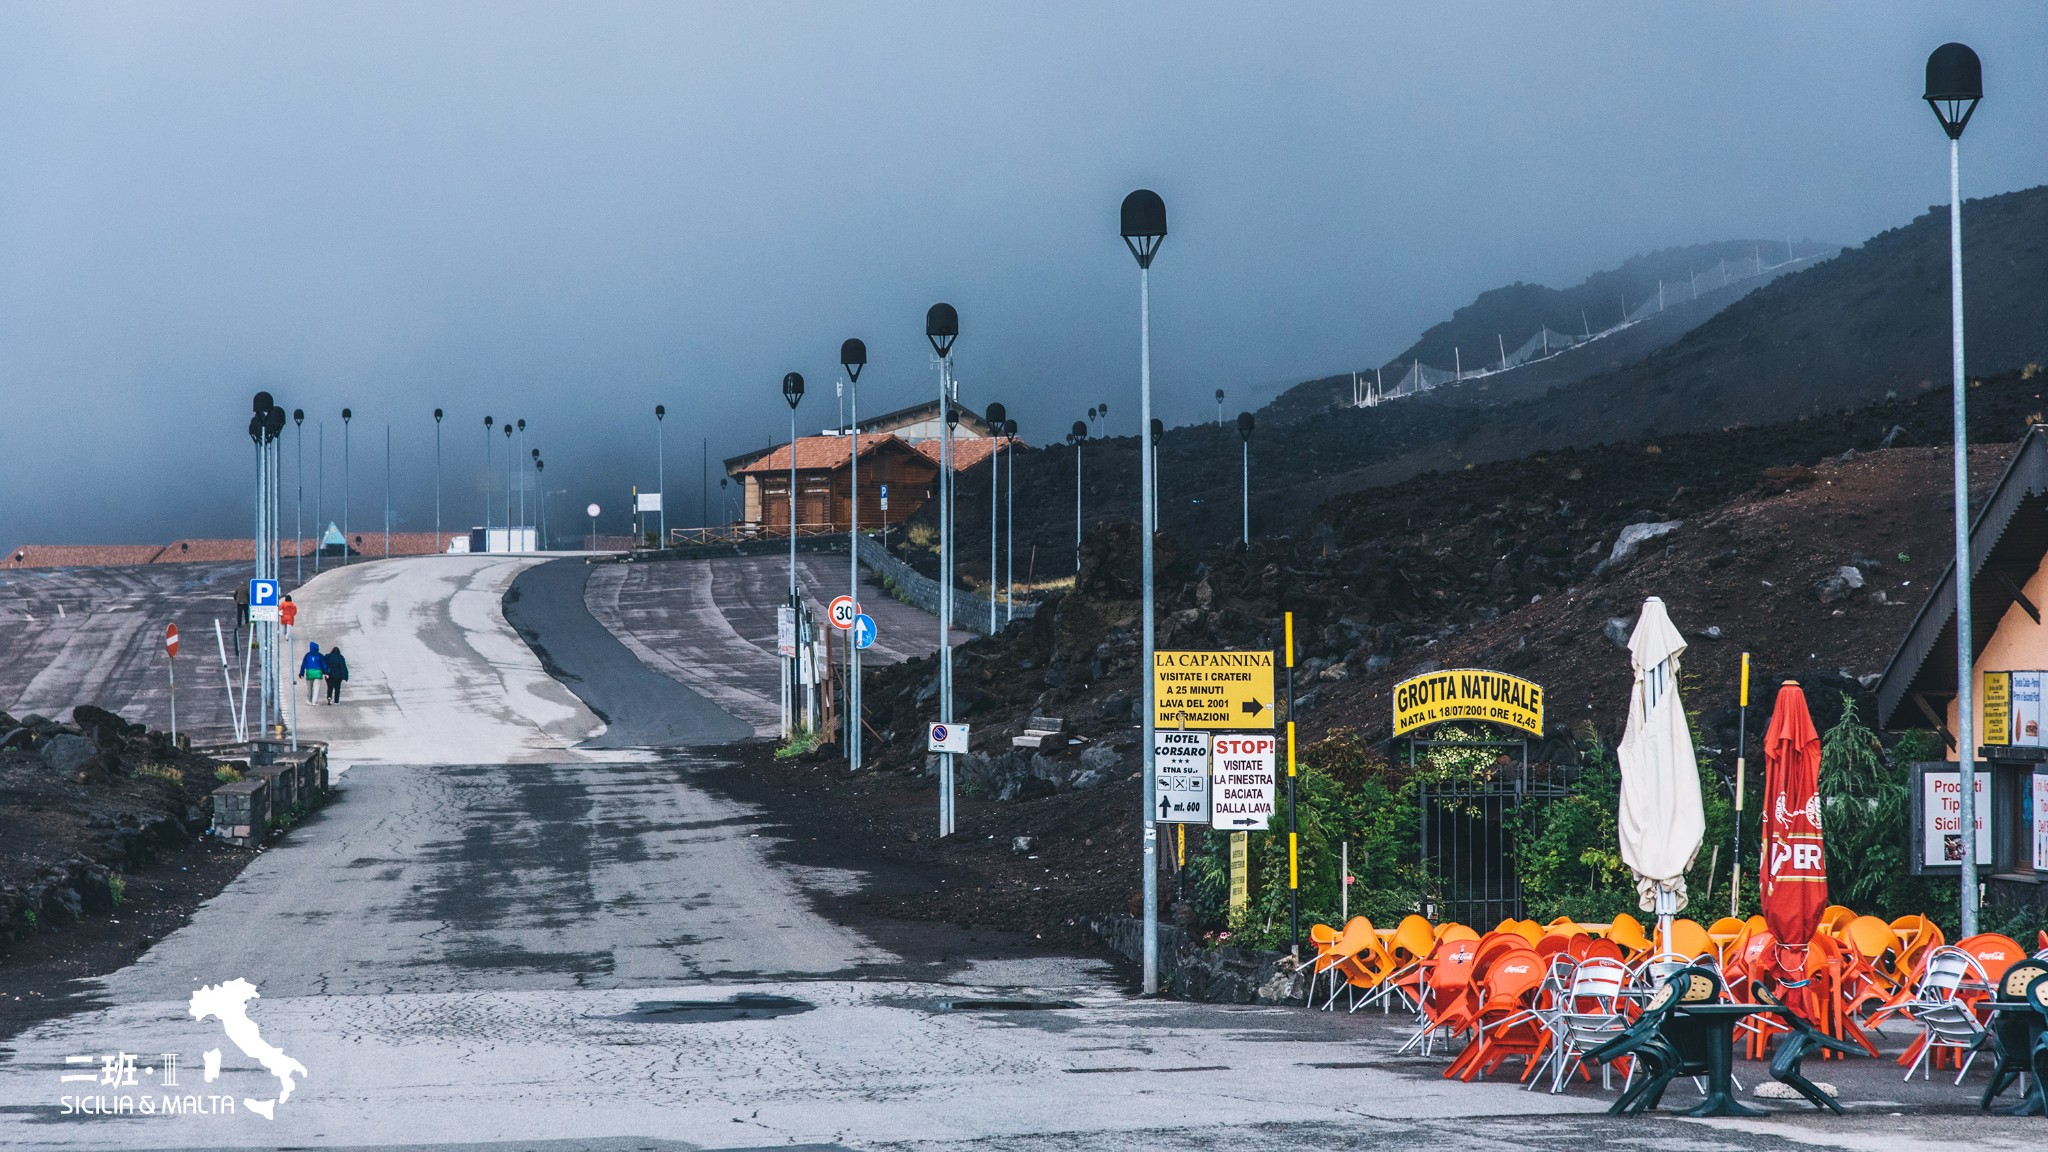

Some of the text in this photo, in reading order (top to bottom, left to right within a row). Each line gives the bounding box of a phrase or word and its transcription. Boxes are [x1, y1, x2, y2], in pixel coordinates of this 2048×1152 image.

[881, 486, 887, 498] P
[256, 582, 274, 605] P
[836, 605, 853, 621] 30
[1156, 654, 1272, 667] LA CAPANNINA
[1160, 672, 1251, 681] VISITATE I CRATERI
[1166, 686, 1224, 694] A 25 MINUTI
[1397, 674, 1540, 714] GROTTA NATURALE
[1160, 699, 1229, 708] LAVA DEL 2001
[1160, 712, 1230, 721] INFORMAZIONI
[1400, 705, 1537, 729] NATA IL 18/07/2001 ORE 12,45
[1164, 734, 1200, 744] HOTEL
[1155, 746, 1206, 756] CORSARO
[1216, 740, 1274, 754] STOP!
[1163, 766, 1181, 774] ETNA
[1223, 760, 1263, 771] VISITATE
[1214, 774, 1273, 785] LA FINESTRA
[1224, 788, 1263, 799] BACIATA
[1173, 801, 1200, 812] mt. 600
[1216, 803, 1272, 813] DALLA LAVA
[1935, 817, 1983, 831] Sicilni
